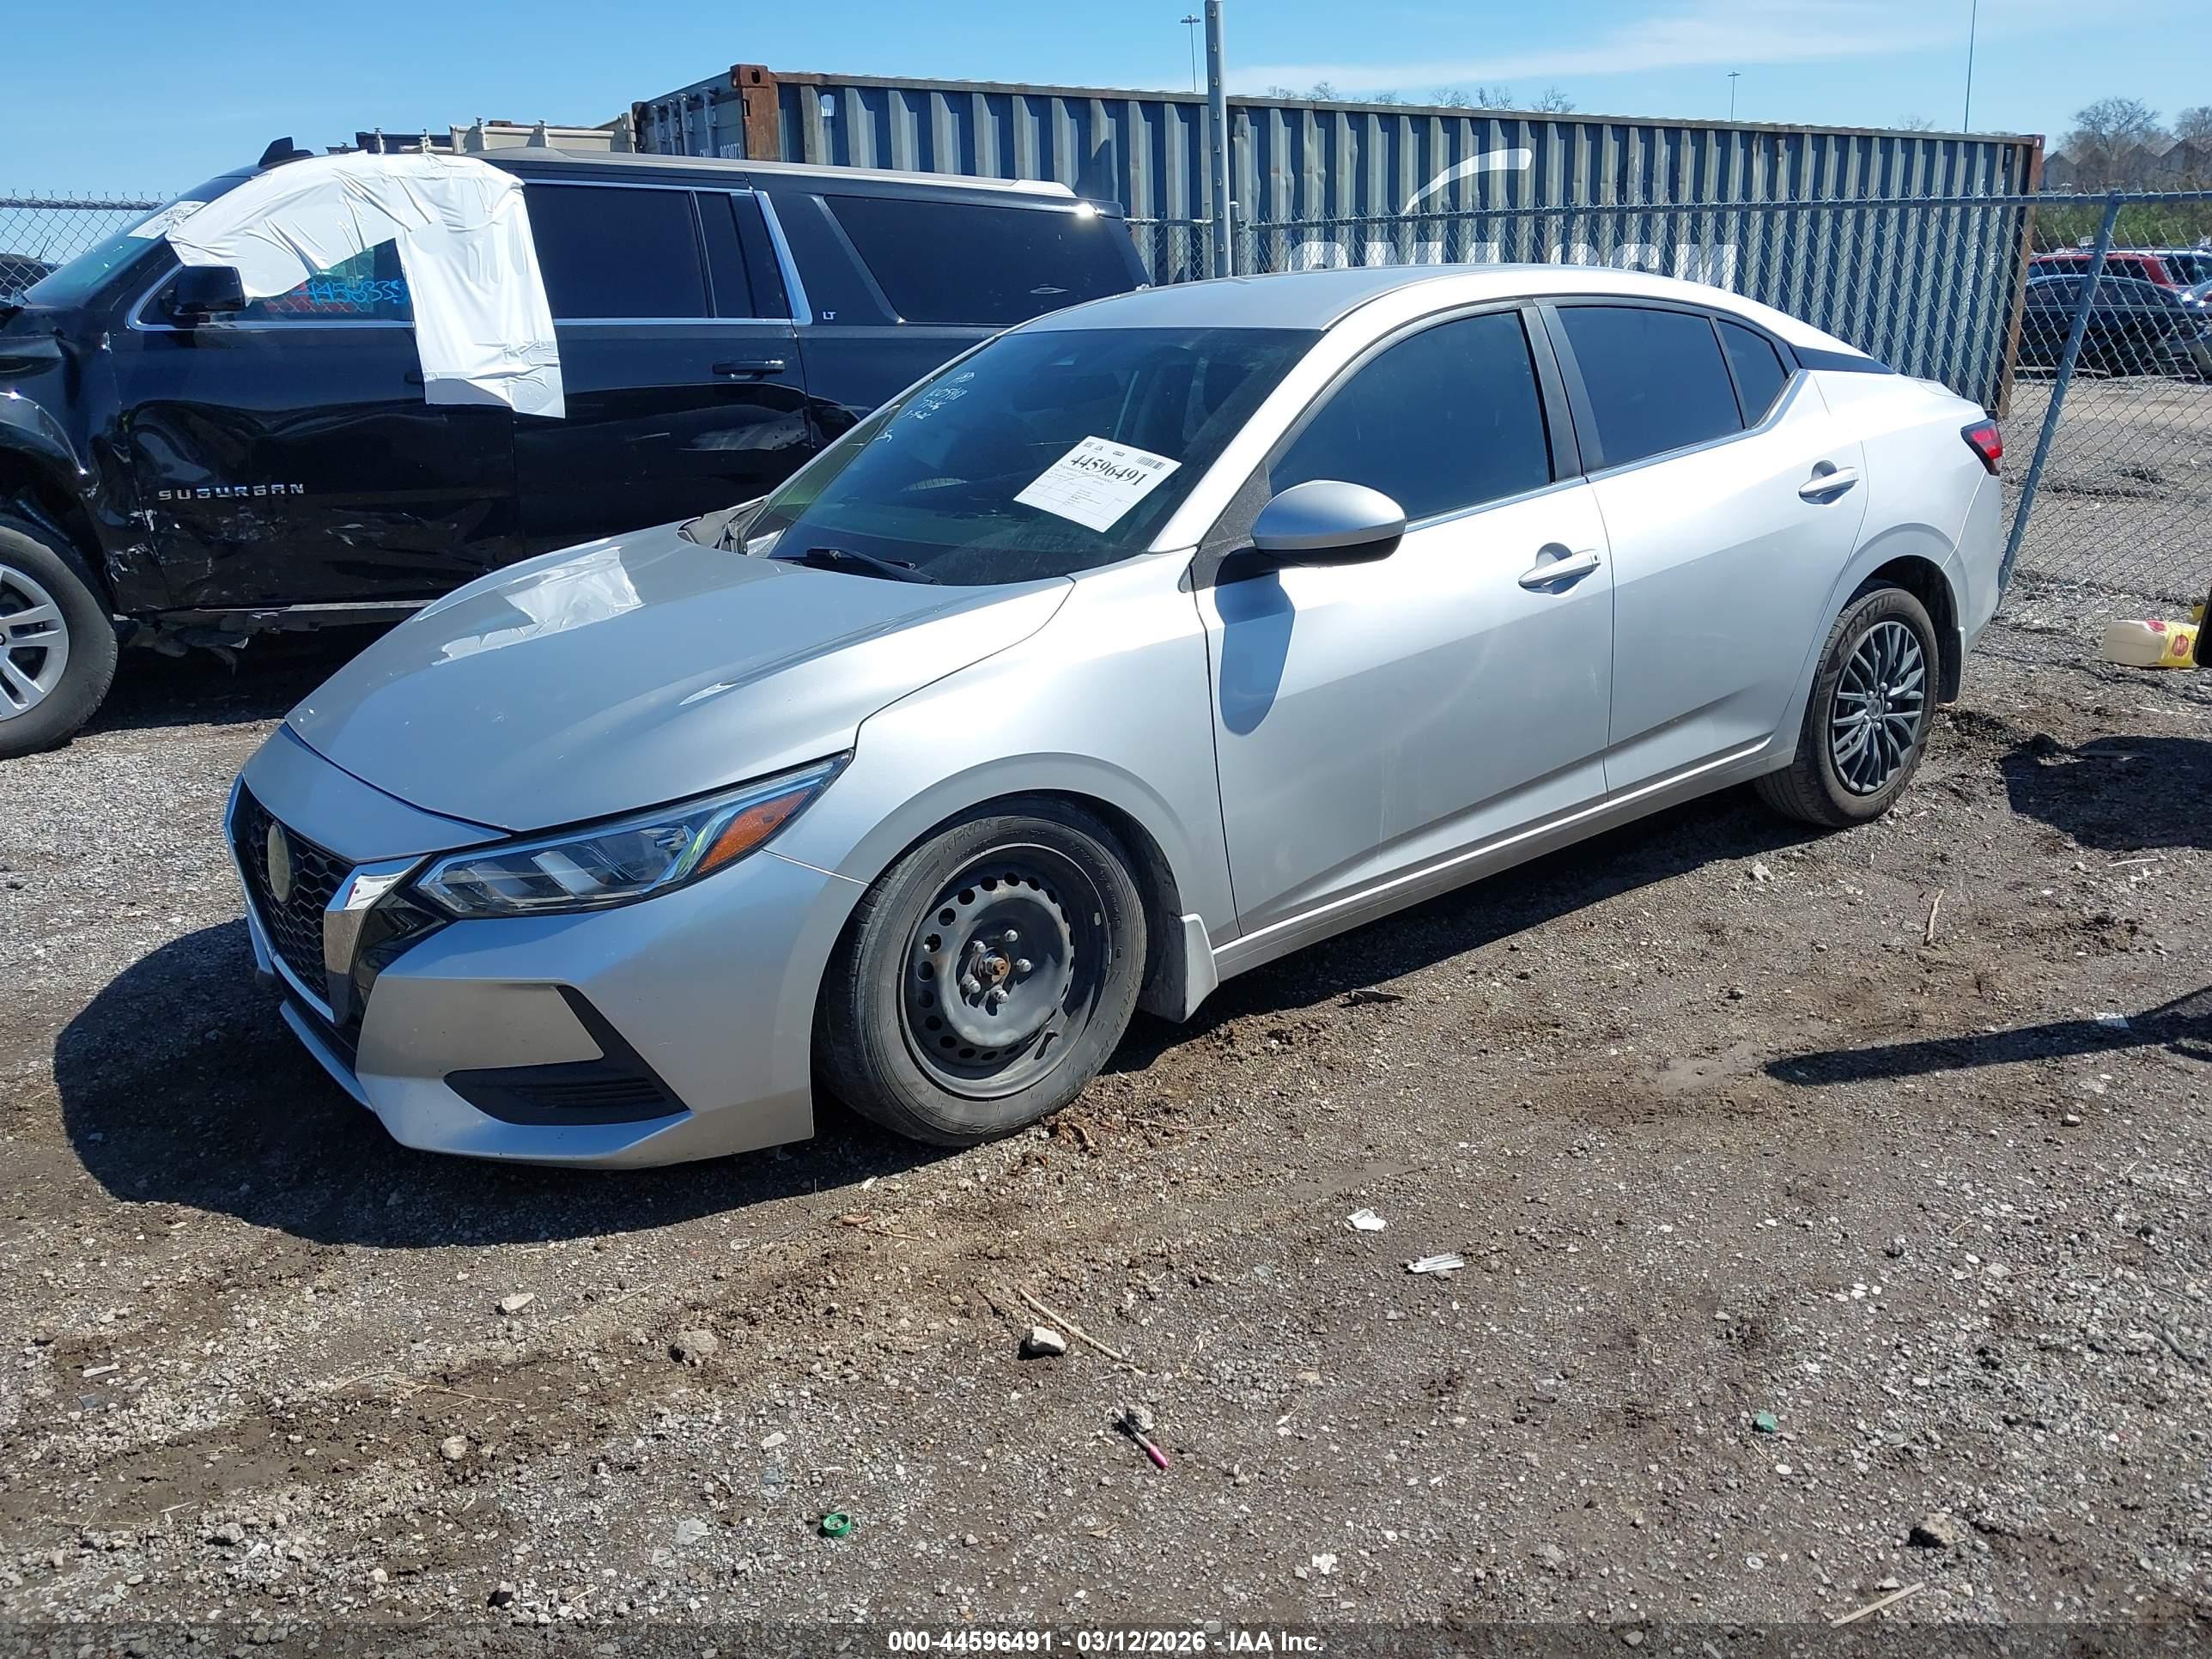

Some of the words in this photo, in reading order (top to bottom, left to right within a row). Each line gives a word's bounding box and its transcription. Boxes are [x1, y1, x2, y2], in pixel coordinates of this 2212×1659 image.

[823, 311, 836, 319] LT
[1071, 454, 1148, 487] 44596491
[158, 483, 304, 501] SUBURBAN
